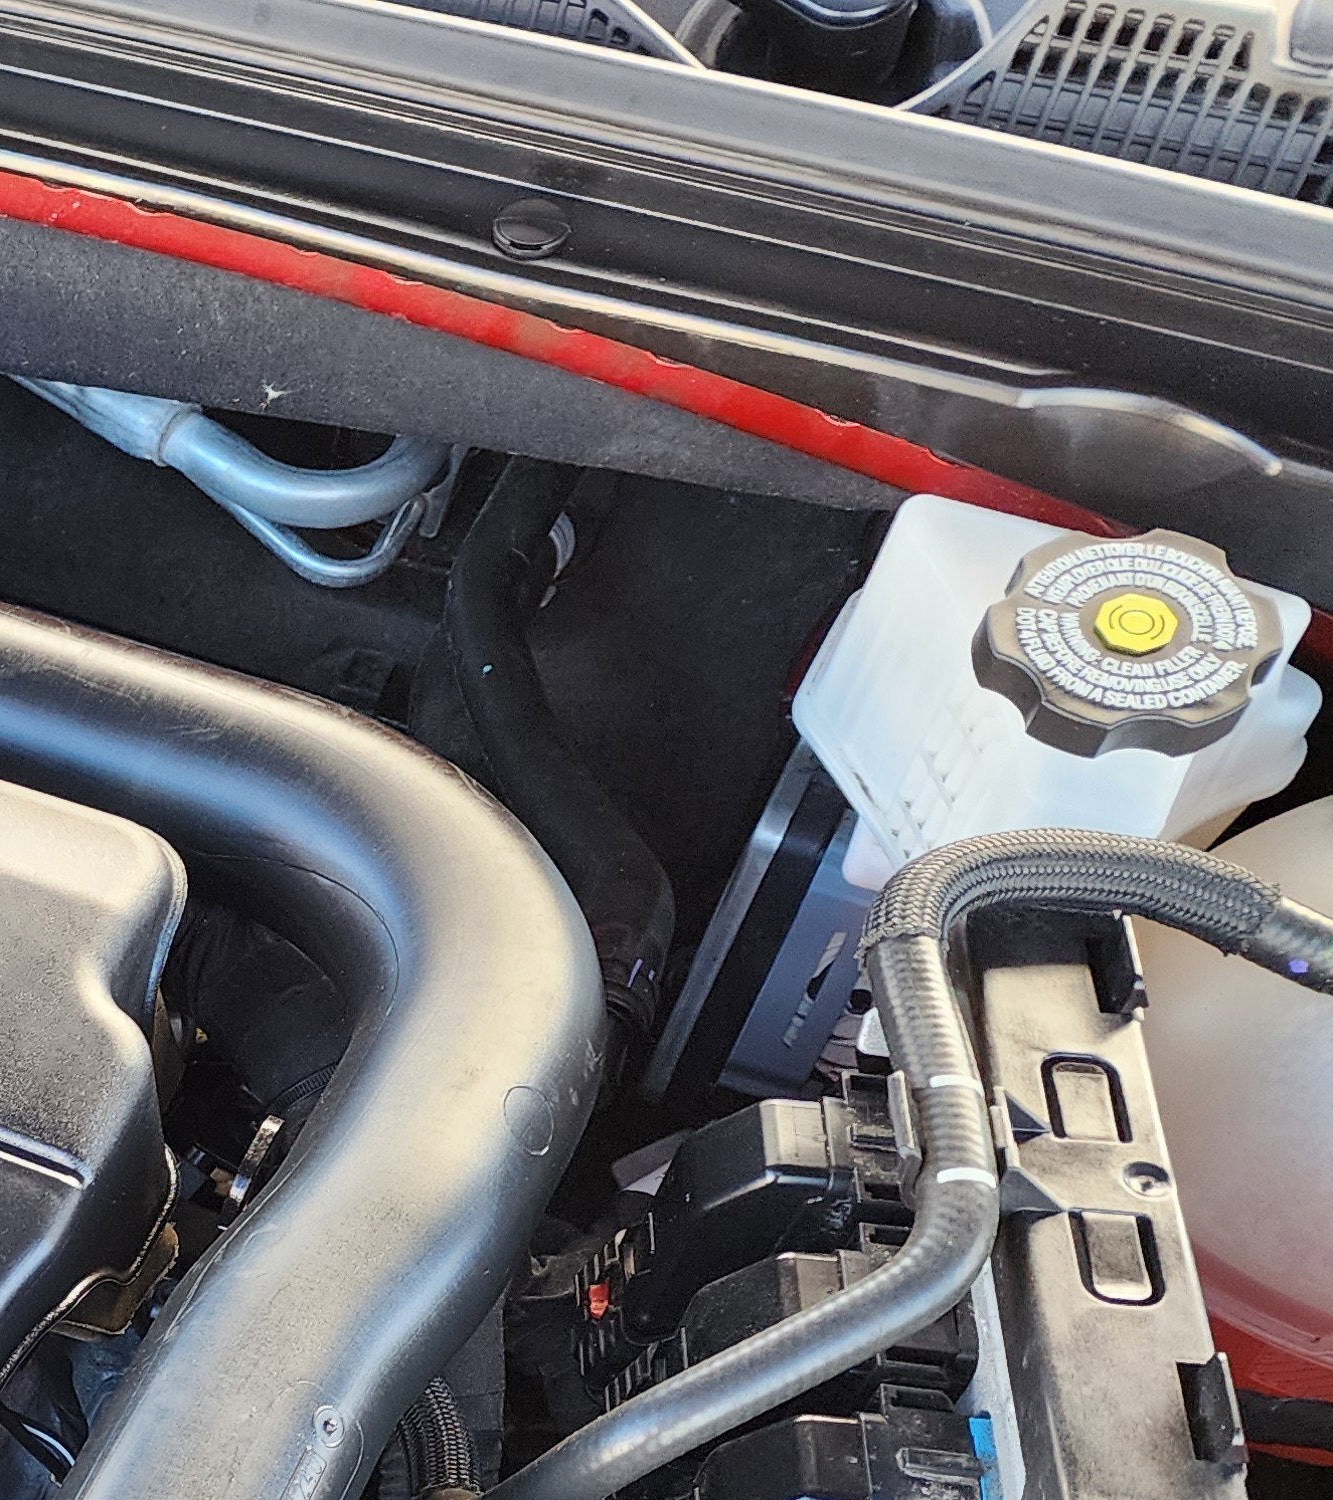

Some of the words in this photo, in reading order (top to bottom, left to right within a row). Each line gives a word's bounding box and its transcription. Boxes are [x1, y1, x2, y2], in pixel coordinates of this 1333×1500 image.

[1036, 608, 1059, 633] CAP
[1041, 633, 1087, 674] BEFORE
[1101, 656, 1154, 677] CLEAN
[1154, 645, 1205, 675] FILLER
[1186, 652, 1223, 680] ONLY
[1020, 637, 1057, 671] FLUID
[1045, 666, 1094, 697] FROM
[1088, 687, 1104, 702] A
[1103, 690, 1168, 710] SEALED
[1077, 665, 1163, 692] REMOVING
[1163, 670, 1194, 691] USE
